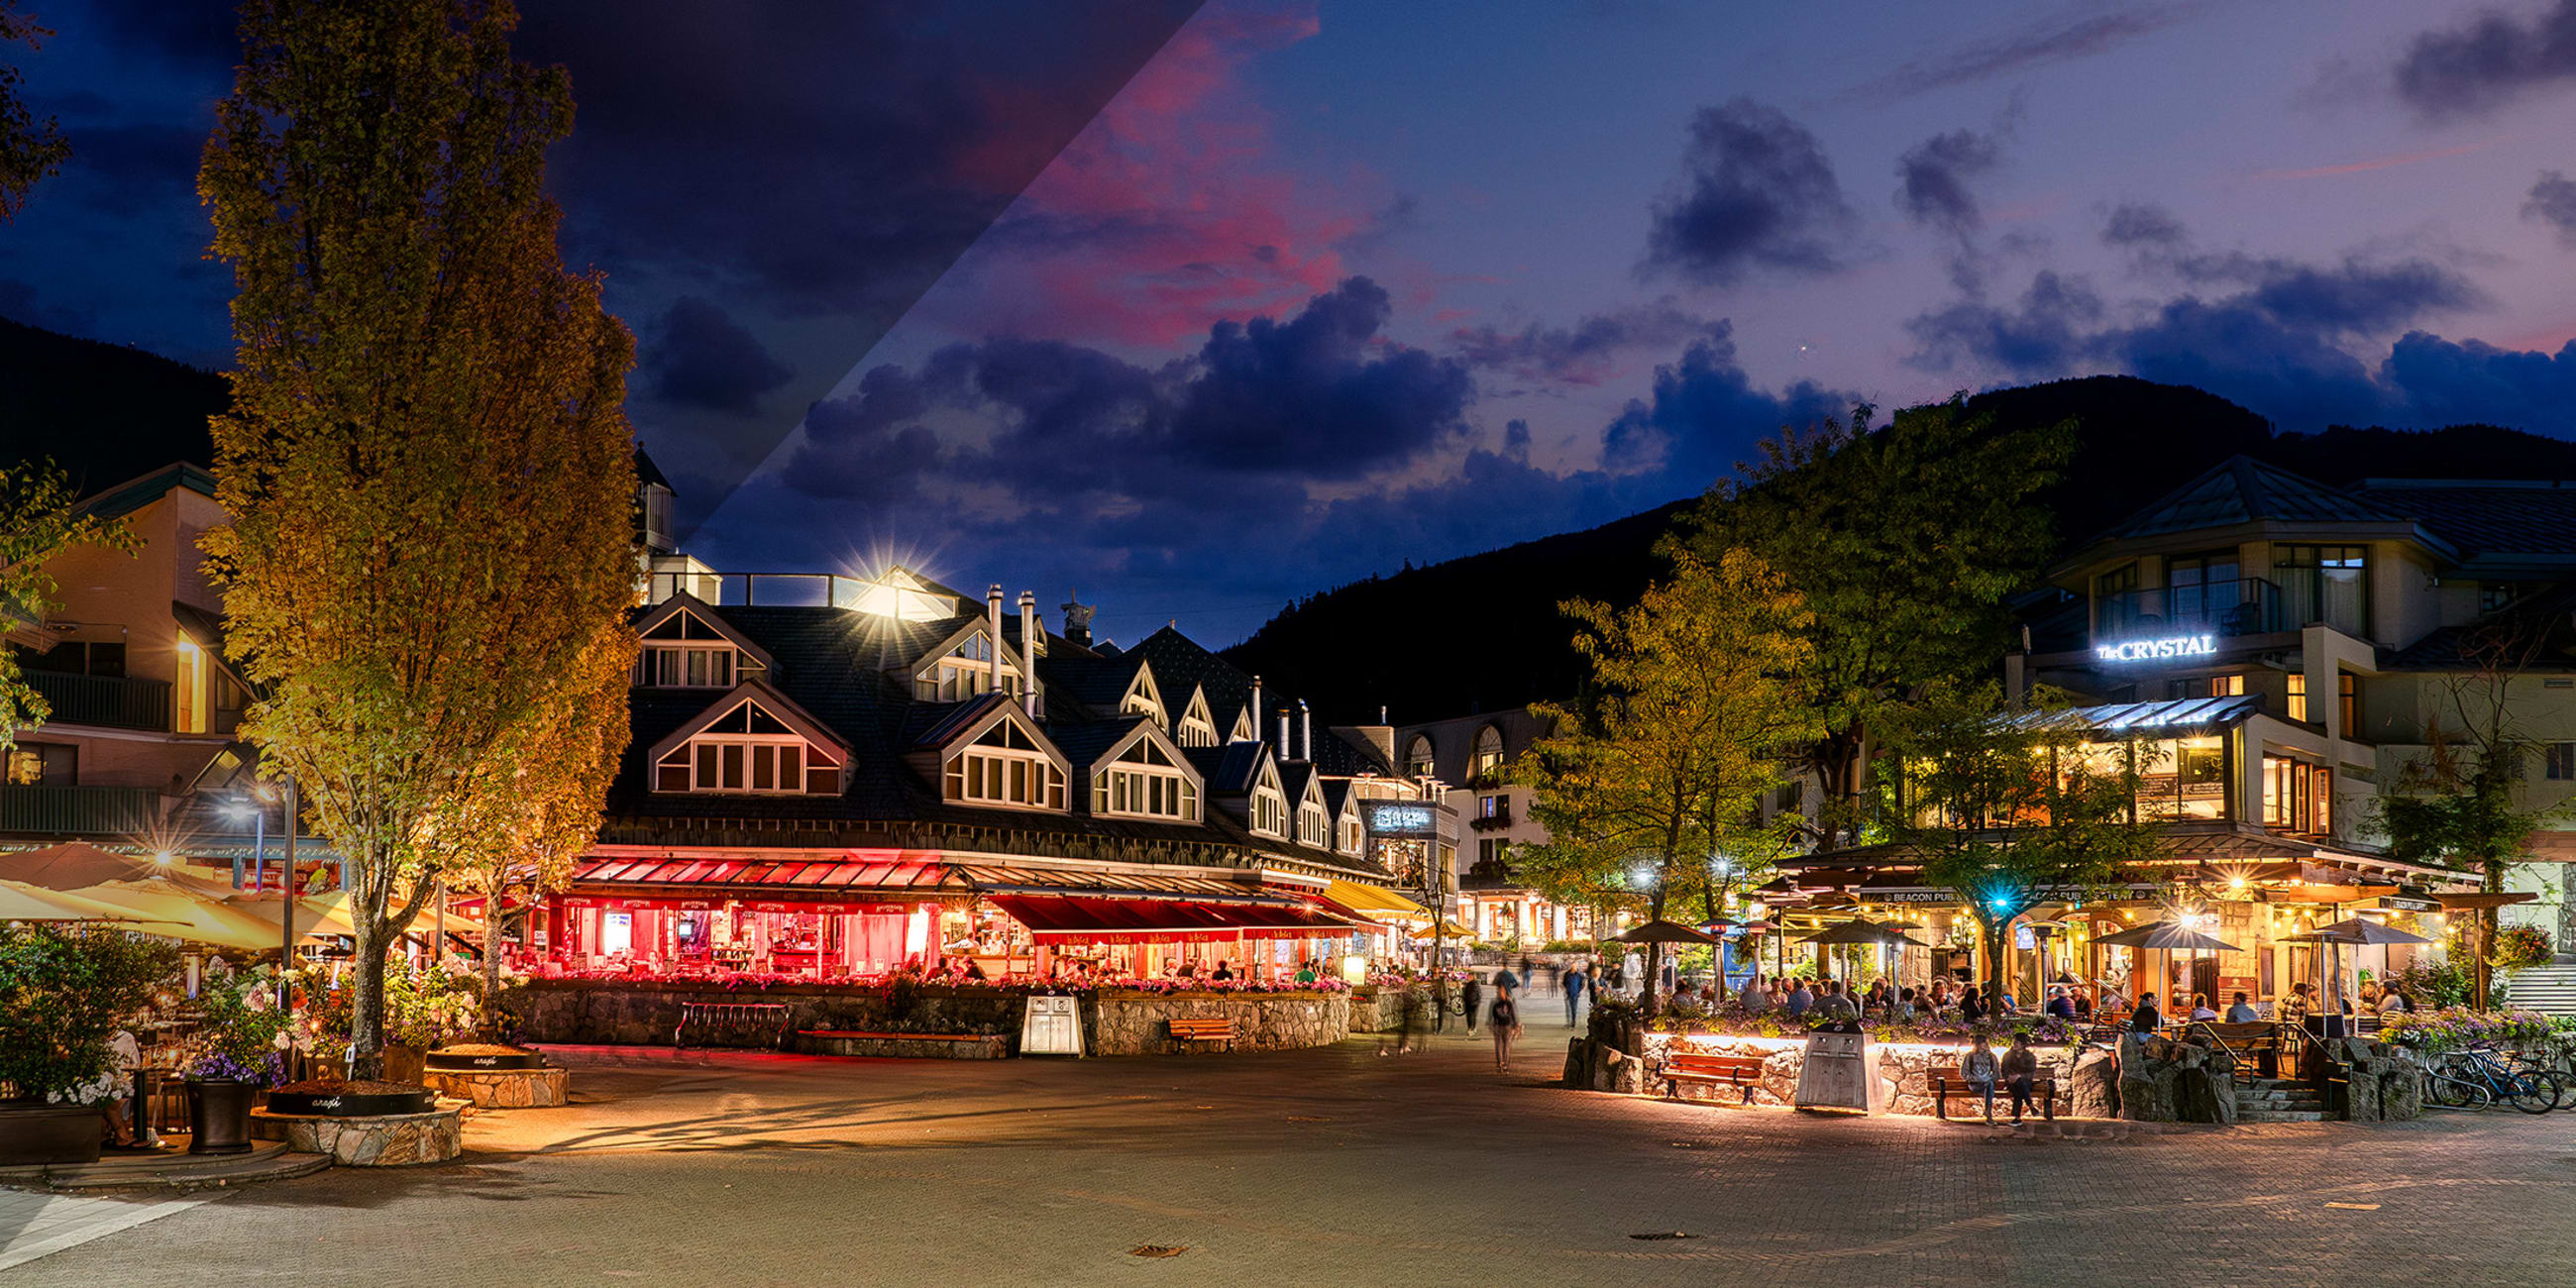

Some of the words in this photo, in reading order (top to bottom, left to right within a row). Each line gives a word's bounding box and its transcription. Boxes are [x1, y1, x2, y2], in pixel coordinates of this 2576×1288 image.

[2117, 635, 2217, 660] CRYSTAL
[1893, 893, 1932, 902] BEACON
[1934, 893, 1954, 902] PUB
